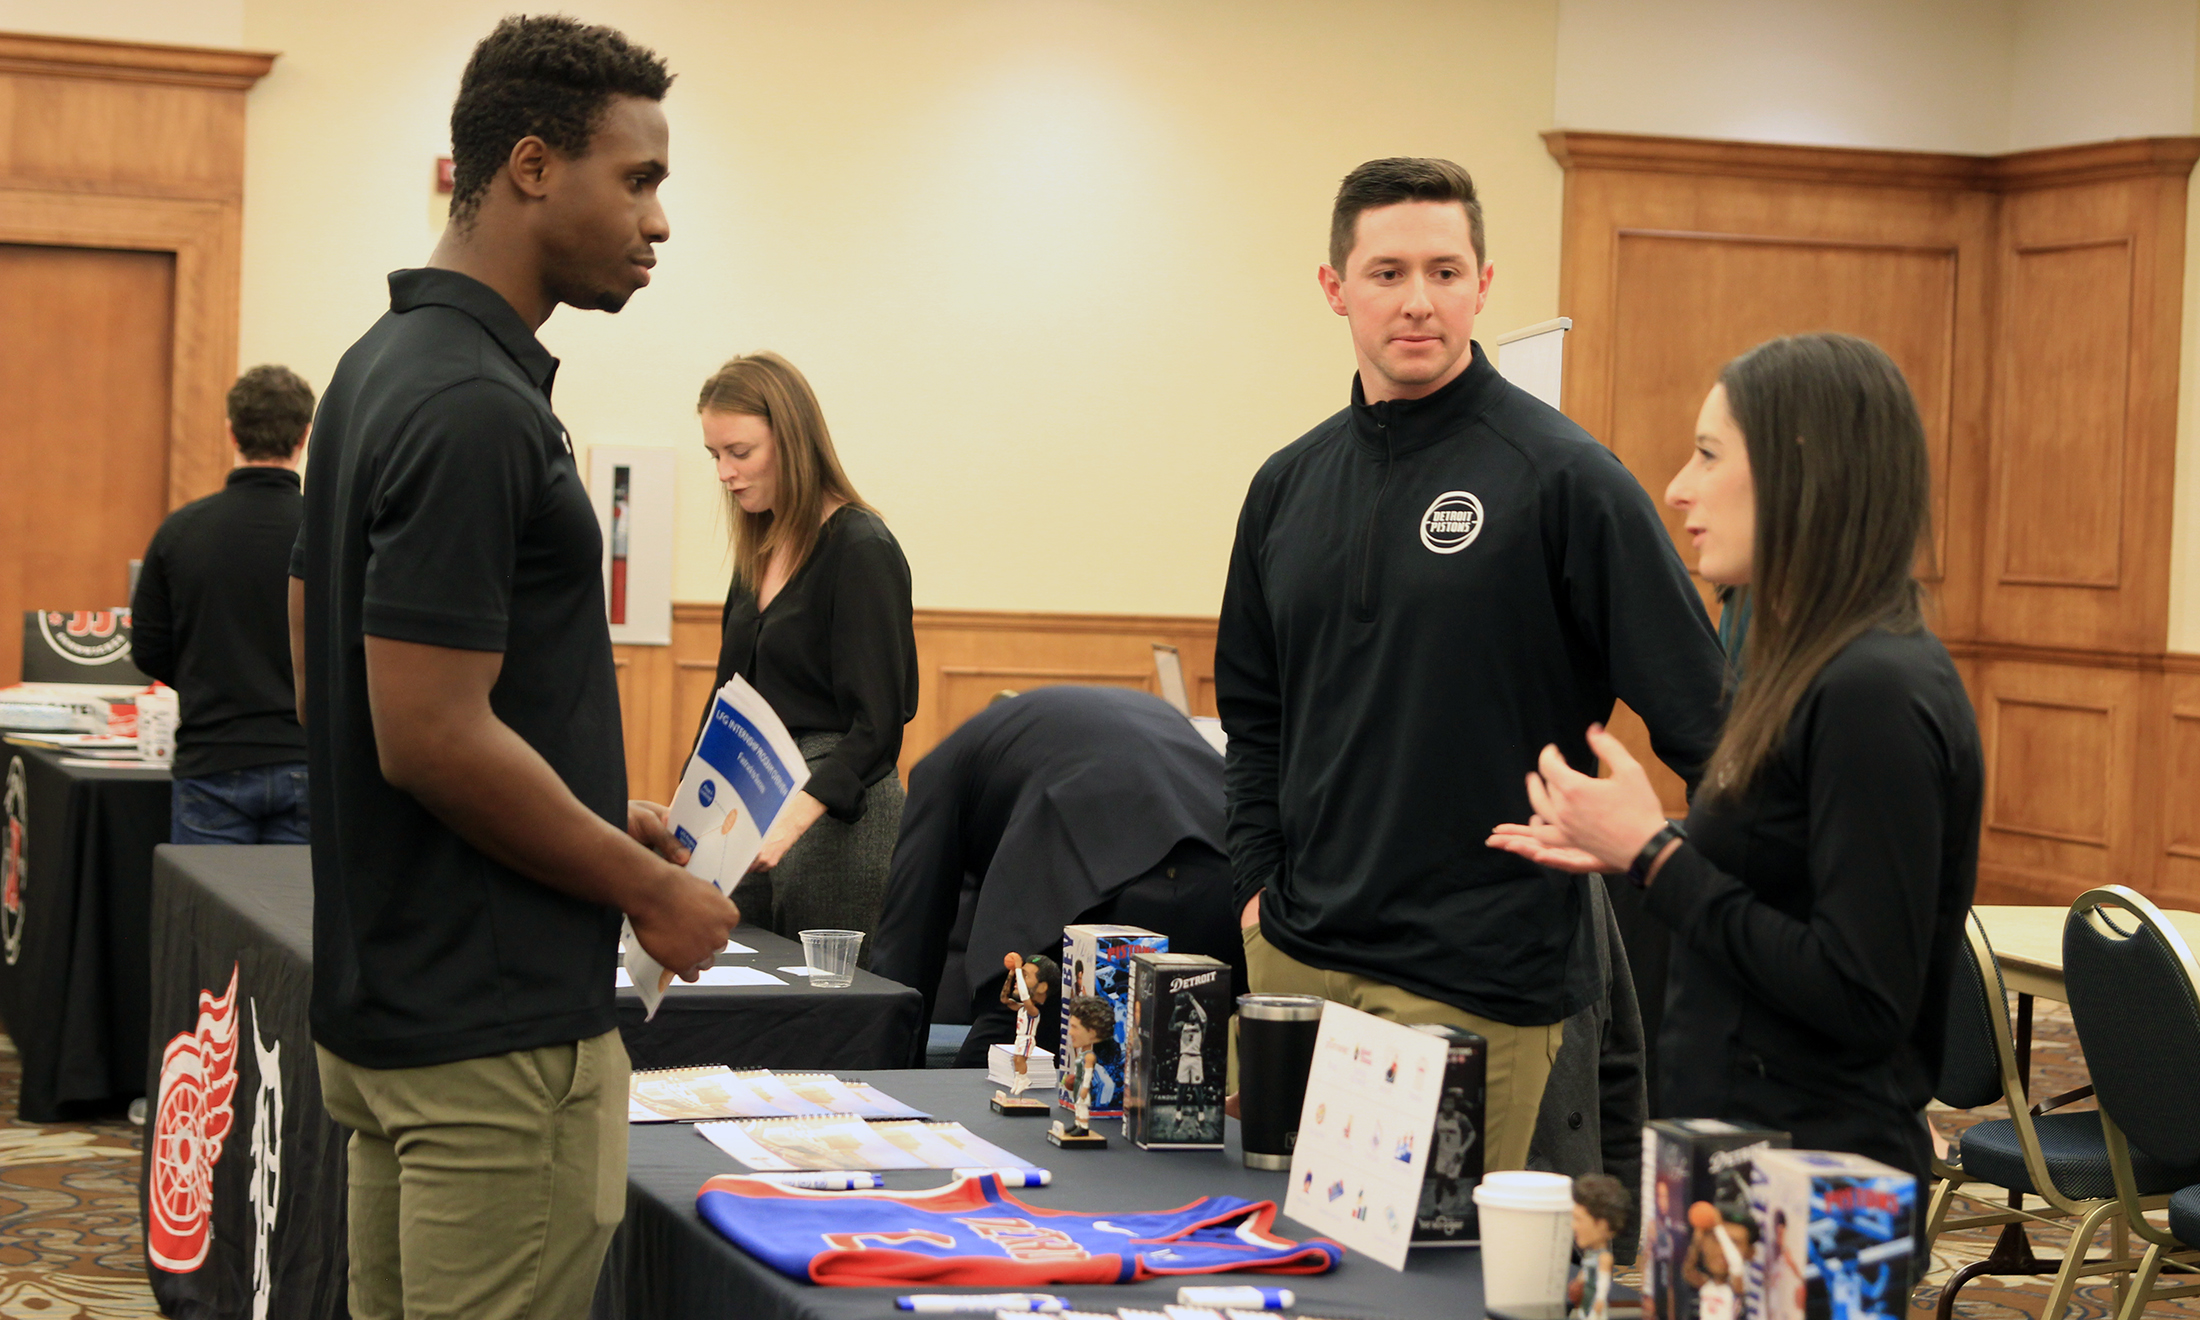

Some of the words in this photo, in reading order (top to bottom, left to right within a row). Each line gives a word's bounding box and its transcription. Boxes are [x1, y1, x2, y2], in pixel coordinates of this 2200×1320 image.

[1433, 510, 1473, 521] DETROIT
[1430, 521, 1471, 533] PISTONS
[1169, 971, 1217, 994] DETROIT
